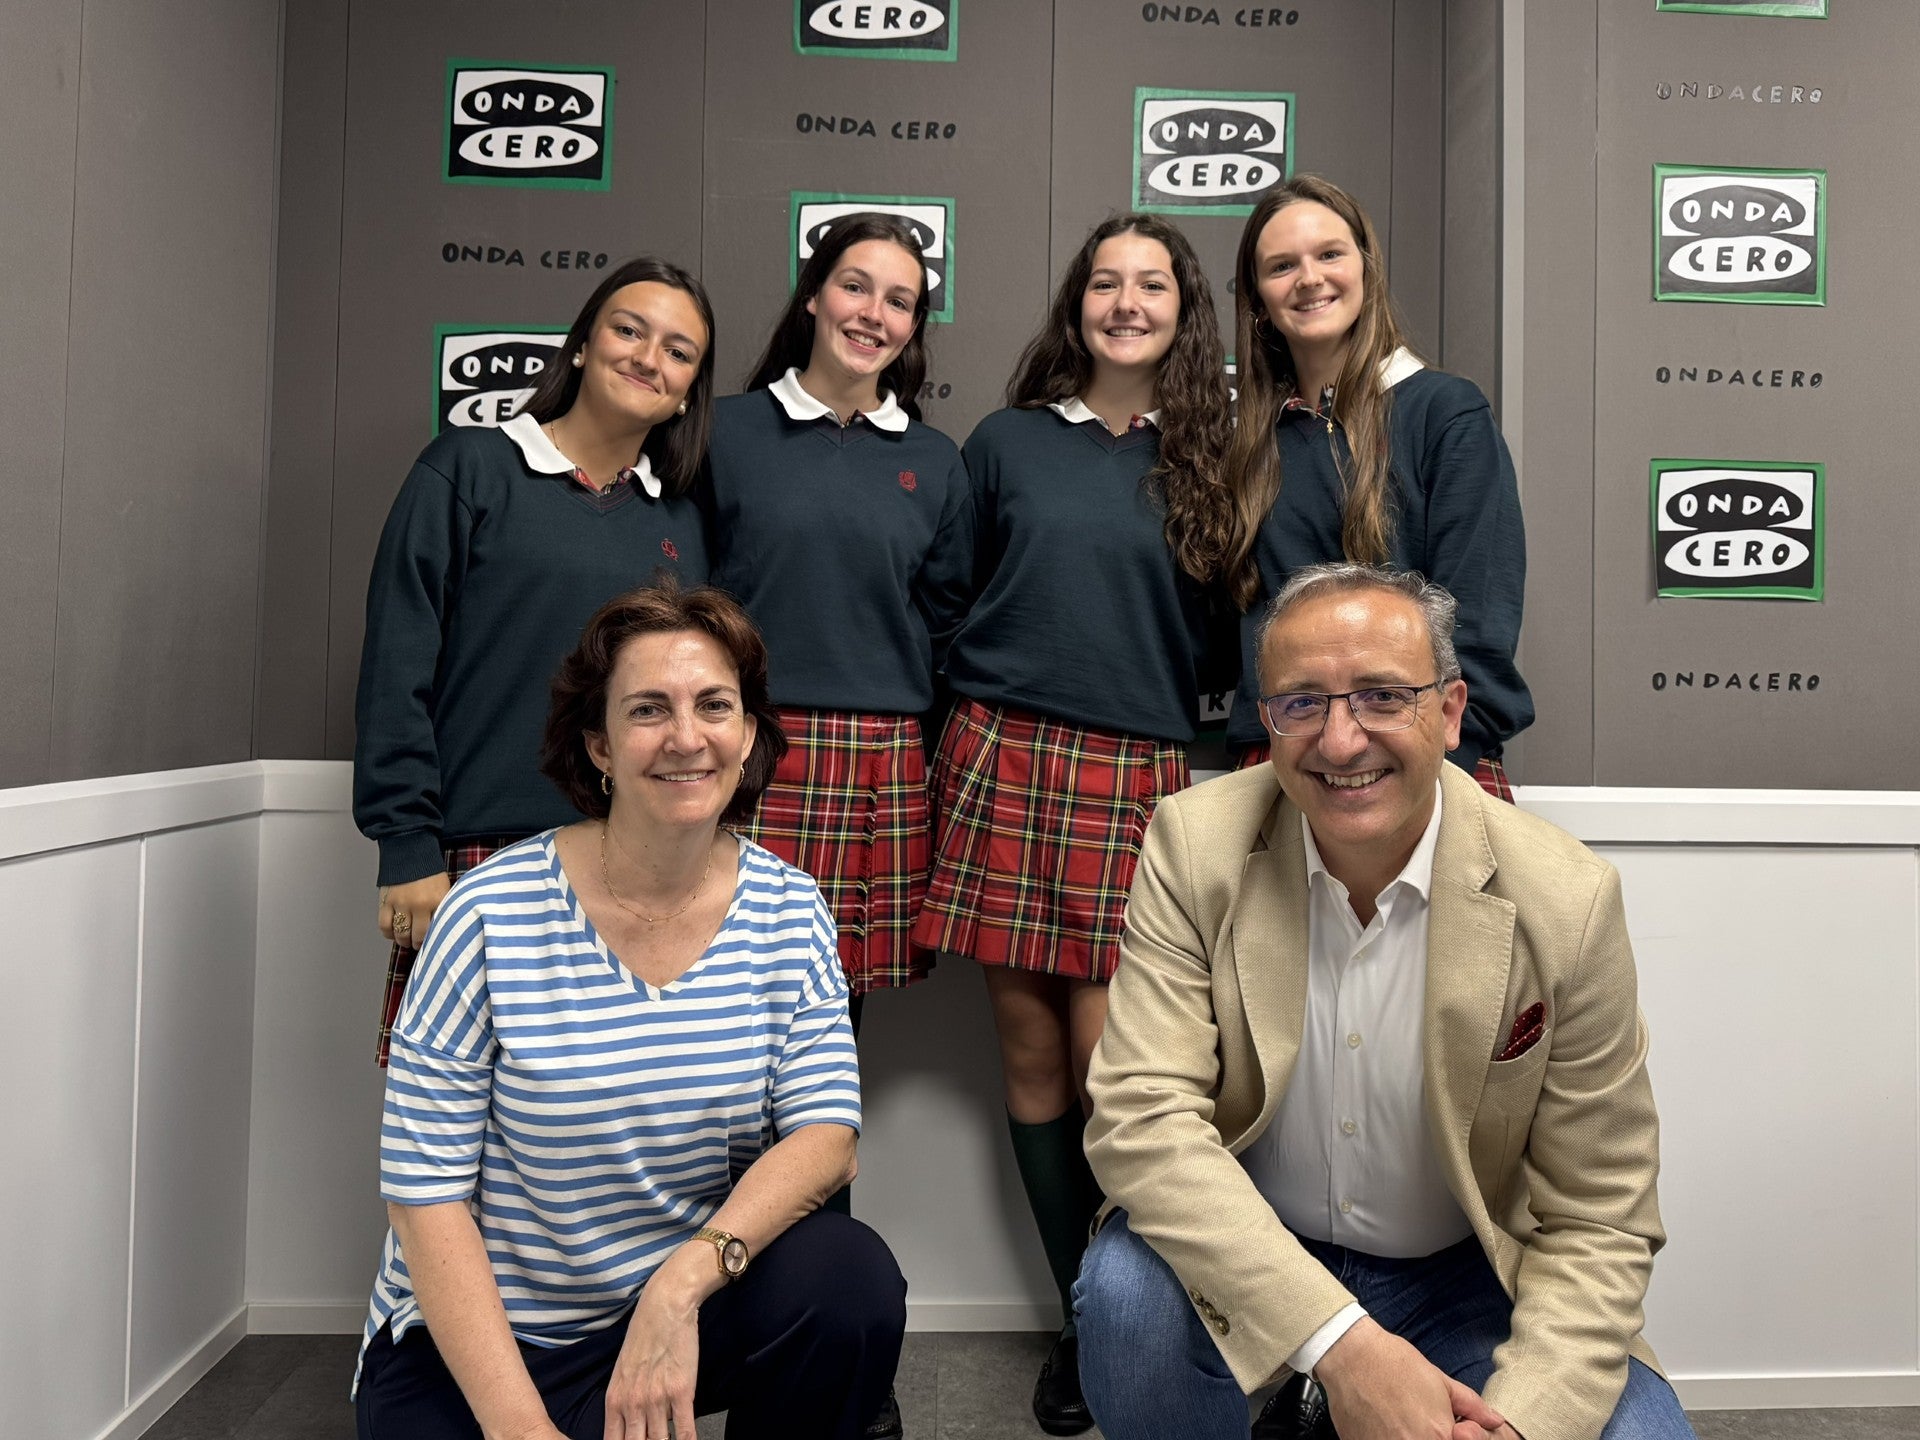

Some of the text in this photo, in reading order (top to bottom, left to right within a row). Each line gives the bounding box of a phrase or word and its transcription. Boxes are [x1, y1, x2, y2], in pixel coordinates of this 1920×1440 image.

[828, 5, 928, 29] CERO
[1141, 2, 1300, 28] ONDA CERO
[474, 91, 581, 114] ONDA
[795, 112, 957, 141] ONDA CERO
[1161, 120, 1264, 143] ONDA
[477, 133, 581, 160] CERO
[1166, 162, 1264, 187] CERO
[1682, 199, 1793, 223] ONDA
[441, 242, 608, 270] ONDA CERO
[1688, 245, 1793, 272] CERO
[462, 355, 545, 378] OND
[919, 381, 952, 400] RO
[467, 397, 514, 423] CE
[1678, 493, 1791, 518] ONDA
[1685, 540, 1791, 567] CERO
